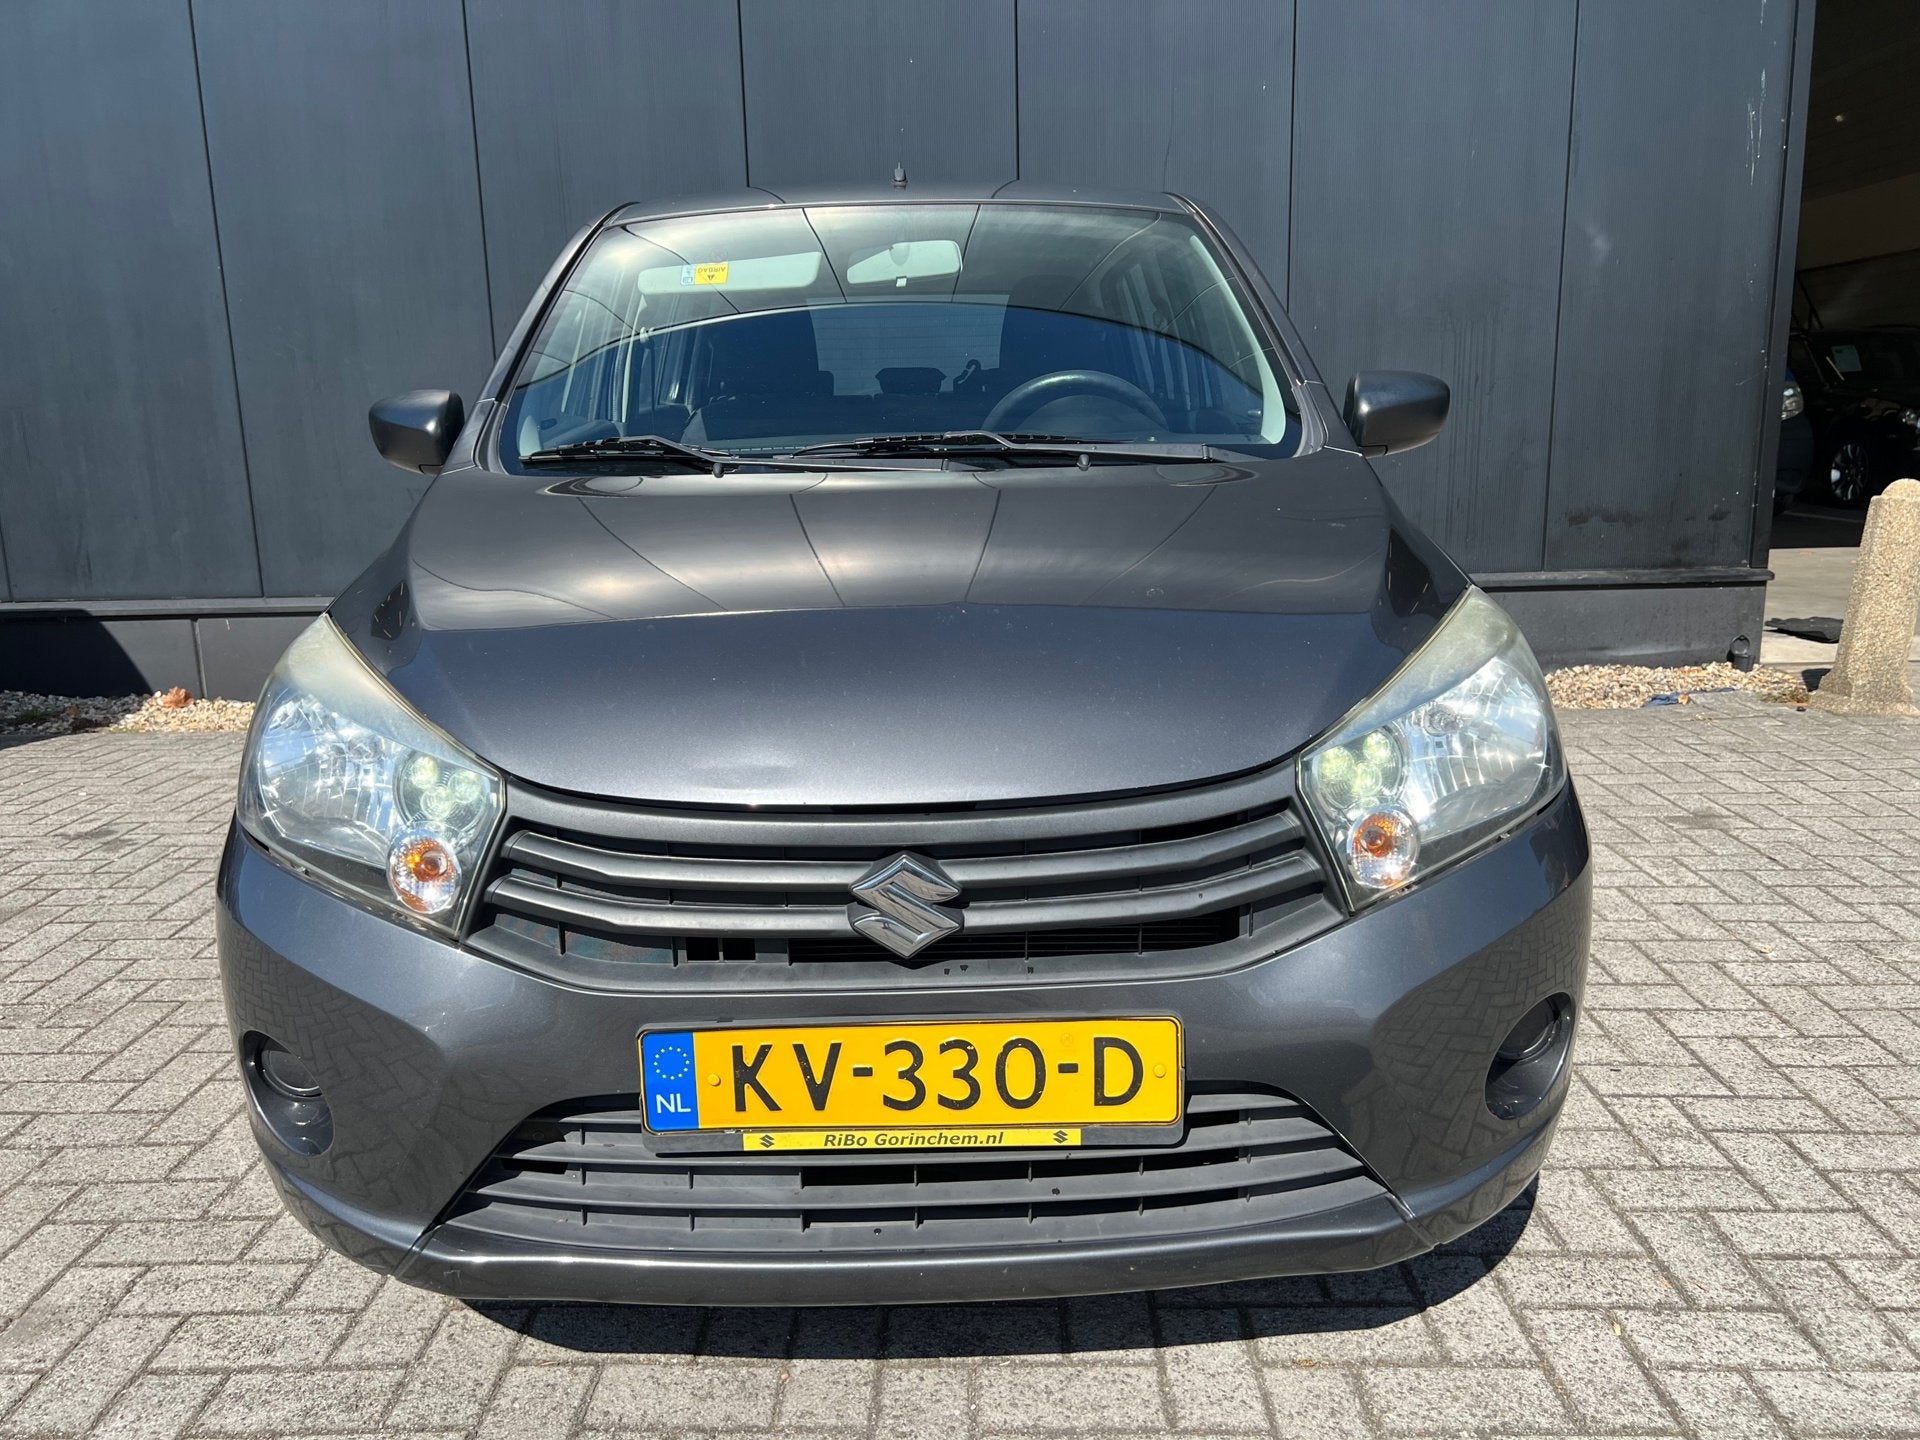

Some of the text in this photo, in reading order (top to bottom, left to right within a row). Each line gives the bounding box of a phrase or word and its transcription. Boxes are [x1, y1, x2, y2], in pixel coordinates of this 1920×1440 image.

[731, 1036, 1144, 1112] KV-330-D
[656, 1093, 691, 1114] NL
[824, 1130, 1004, 1147] RiBo Gorinchem.nl
